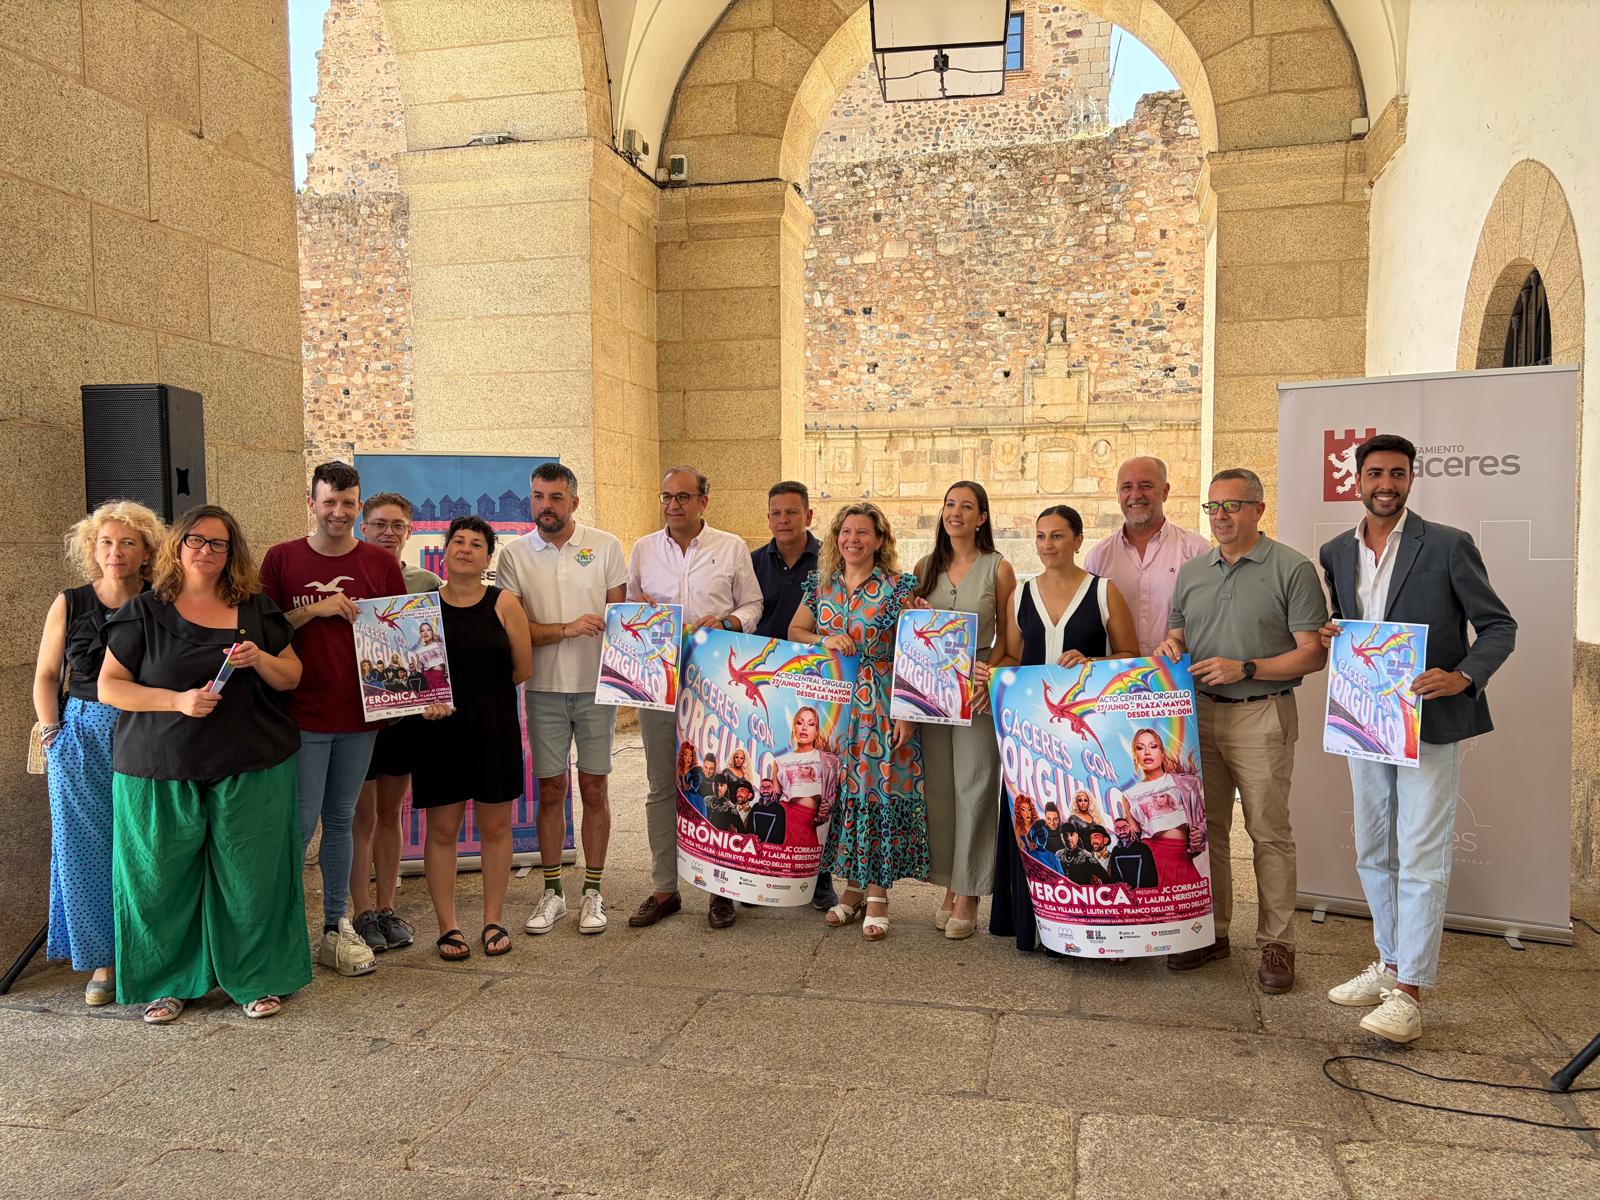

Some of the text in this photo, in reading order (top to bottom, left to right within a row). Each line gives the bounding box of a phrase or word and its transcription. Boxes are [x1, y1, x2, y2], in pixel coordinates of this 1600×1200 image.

[1415, 445, 1464, 454] AMIENTO
[1413, 454, 1521, 478] áceres
[794, 674, 820, 684] CENTRAL
[821, 679, 852, 689] ORGULLO
[796, 690, 816, 698] DESDE
[805, 684, 827, 693] PLAZA
[828, 687, 851, 696] MAYOR
[1099, 691, 1190, 703] ACTO CENTRAL ORGULLO
[1136, 701, 1161, 709] PLAZA
[1162, 699, 1191, 708] MAYOR
[1127, 708, 1192, 718] DESDE LAS 21:00H
[749, 713, 774, 752] CON
[1082, 749, 1118, 786] CON
[768, 851, 790, 860] LAURA
[748, 858, 771, 866] FRANCO
[1171, 880, 1208, 893] CORRALES
[1144, 896, 1171, 904] LAURA
[1171, 889, 1208, 901] HERISTONE
[1123, 907, 1150, 915] FRANCO
